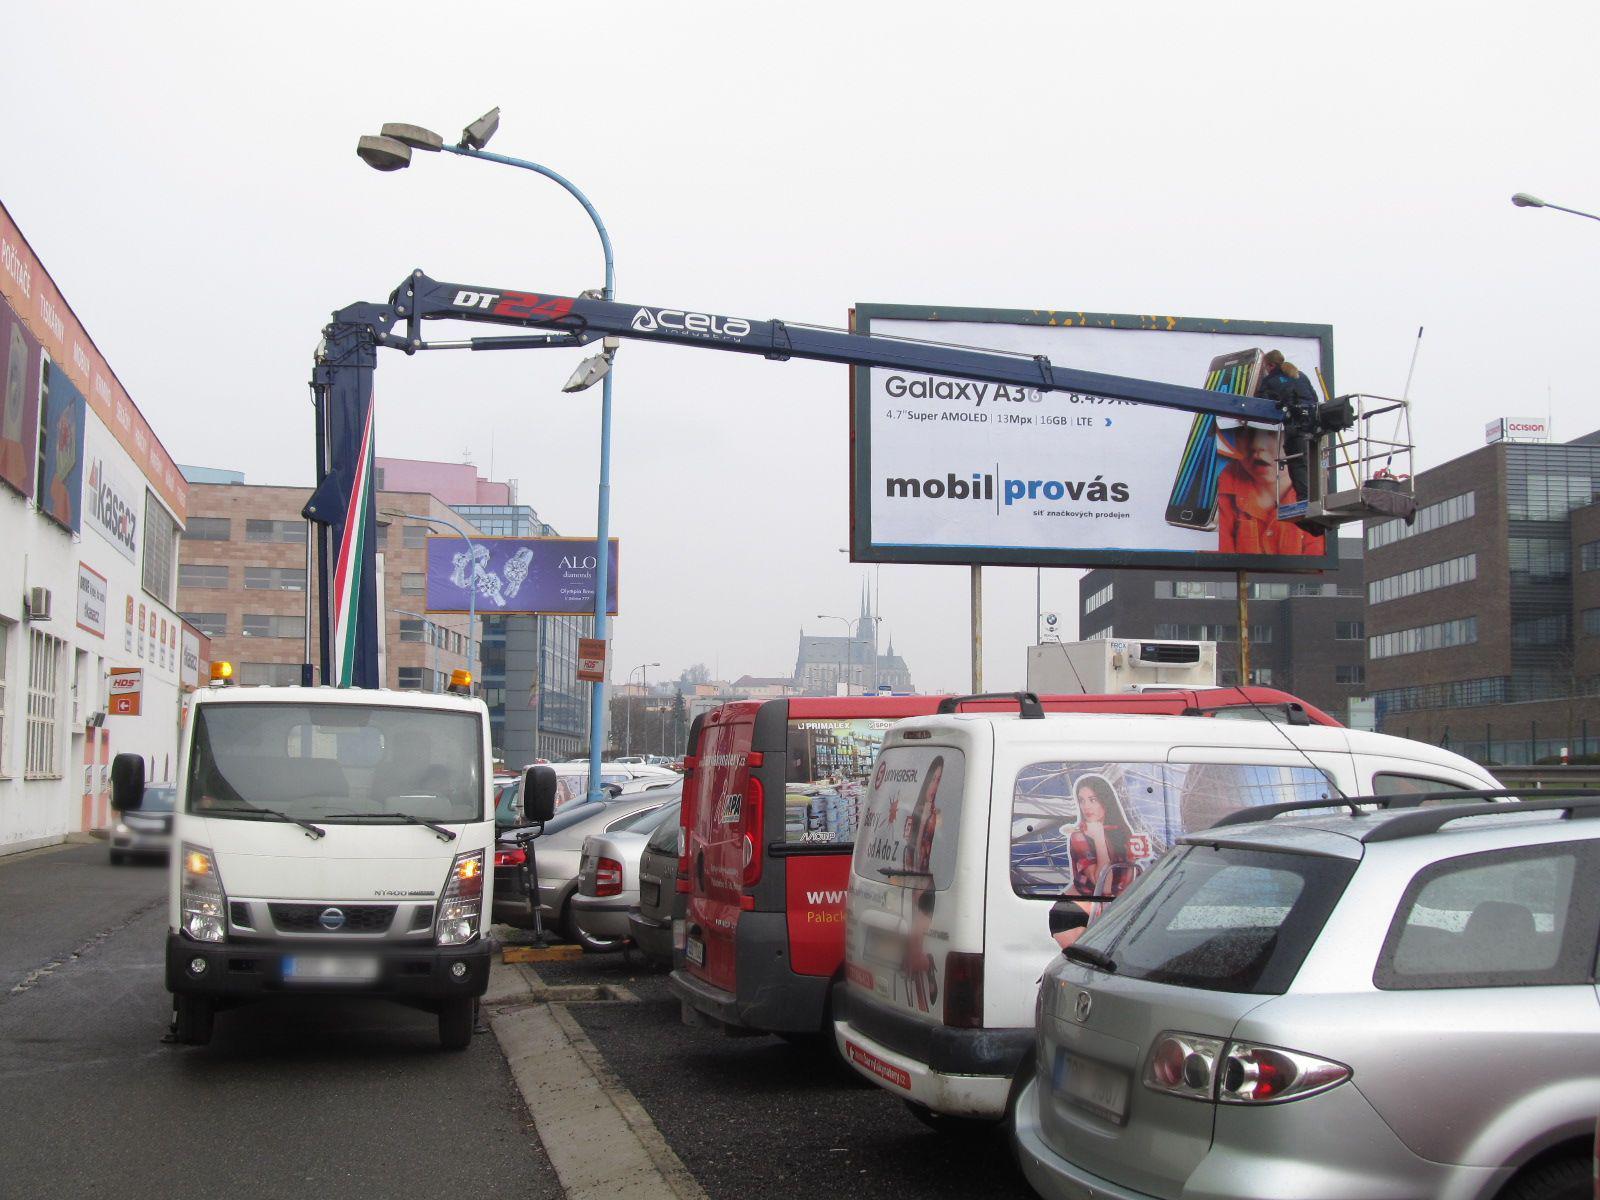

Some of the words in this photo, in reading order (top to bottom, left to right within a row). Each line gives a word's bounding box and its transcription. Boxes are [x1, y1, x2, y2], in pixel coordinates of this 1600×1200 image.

[885, 375, 989, 407] Galaxy
[941, 411, 988, 423] AMOLED
[997, 413, 1032, 425] 13Mpx
[1040, 415, 1067, 426] 16GB
[1076, 416, 1093, 427] LTE
[886, 472, 993, 501] mobil
[1004, 474, 1130, 506] provás
[1095, 511, 1130, 520] prodejen
[558, 555, 597, 569] ALO
[113, 679, 136, 687] HDS
[805, 722, 850, 730] PRIMALEX
